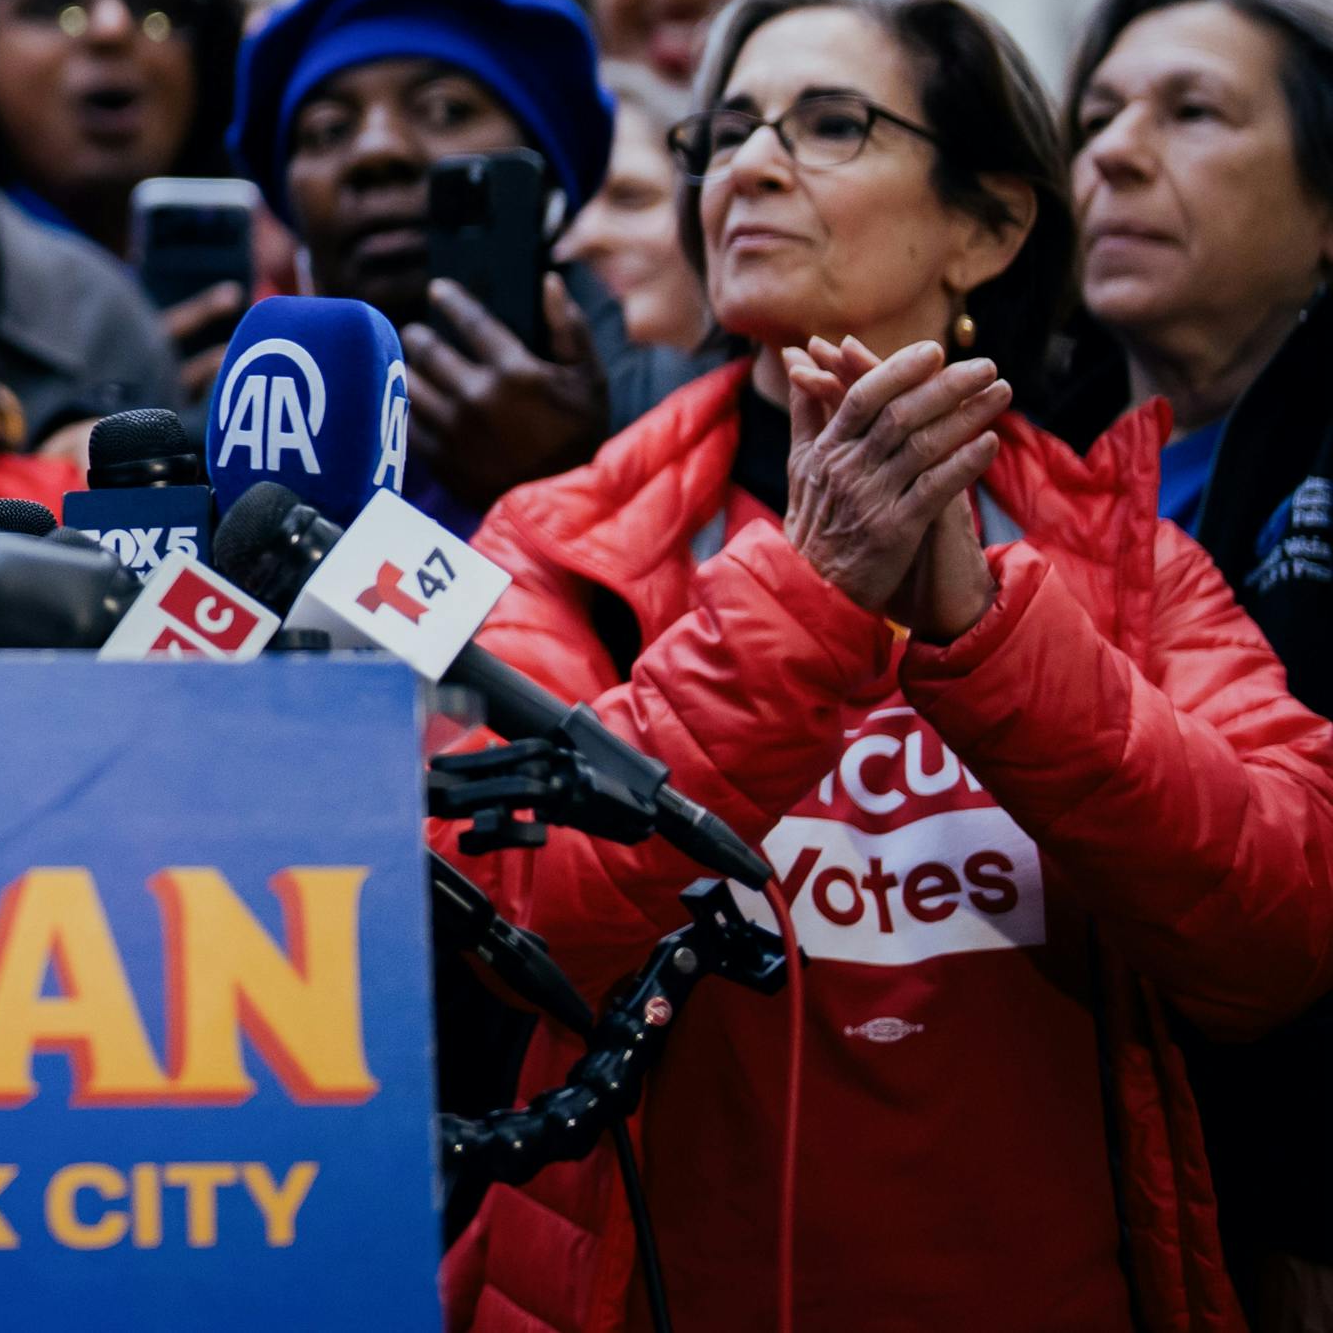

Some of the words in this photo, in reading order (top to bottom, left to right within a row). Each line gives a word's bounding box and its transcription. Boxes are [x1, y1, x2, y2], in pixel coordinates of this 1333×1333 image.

[217, 374, 321, 474] AA
[165, 526, 199, 560] 5
[416, 547, 456, 600] 47
[44, 1161, 320, 1251] CITY
